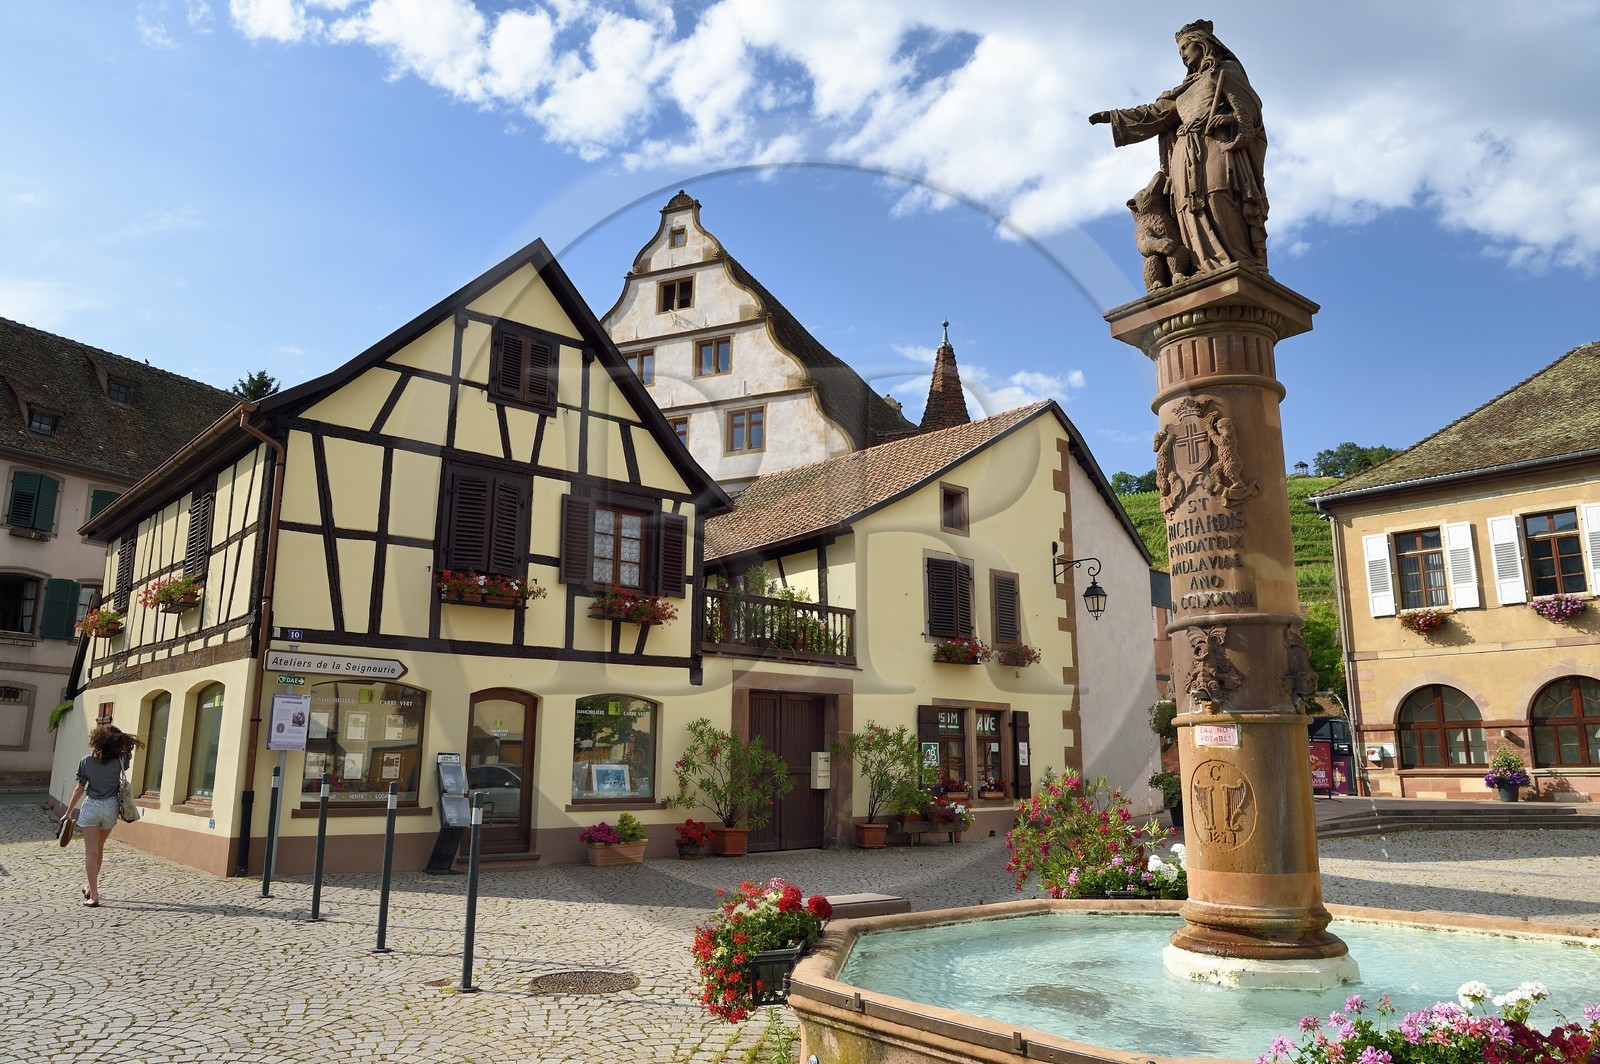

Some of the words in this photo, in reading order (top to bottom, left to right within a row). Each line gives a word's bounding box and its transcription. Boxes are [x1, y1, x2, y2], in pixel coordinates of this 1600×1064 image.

[1187, 497, 1209, 514] ST
[1168, 511, 1246, 542] RICHARDIS
[1190, 575, 1225, 591] ANO
[289, 630, 301, 639] 10
[271, 656, 312, 668] Ateliers
[316, 660, 328, 669] de
[332, 661, 341, 670] la
[345, 662, 396, 674] Seigneurie
